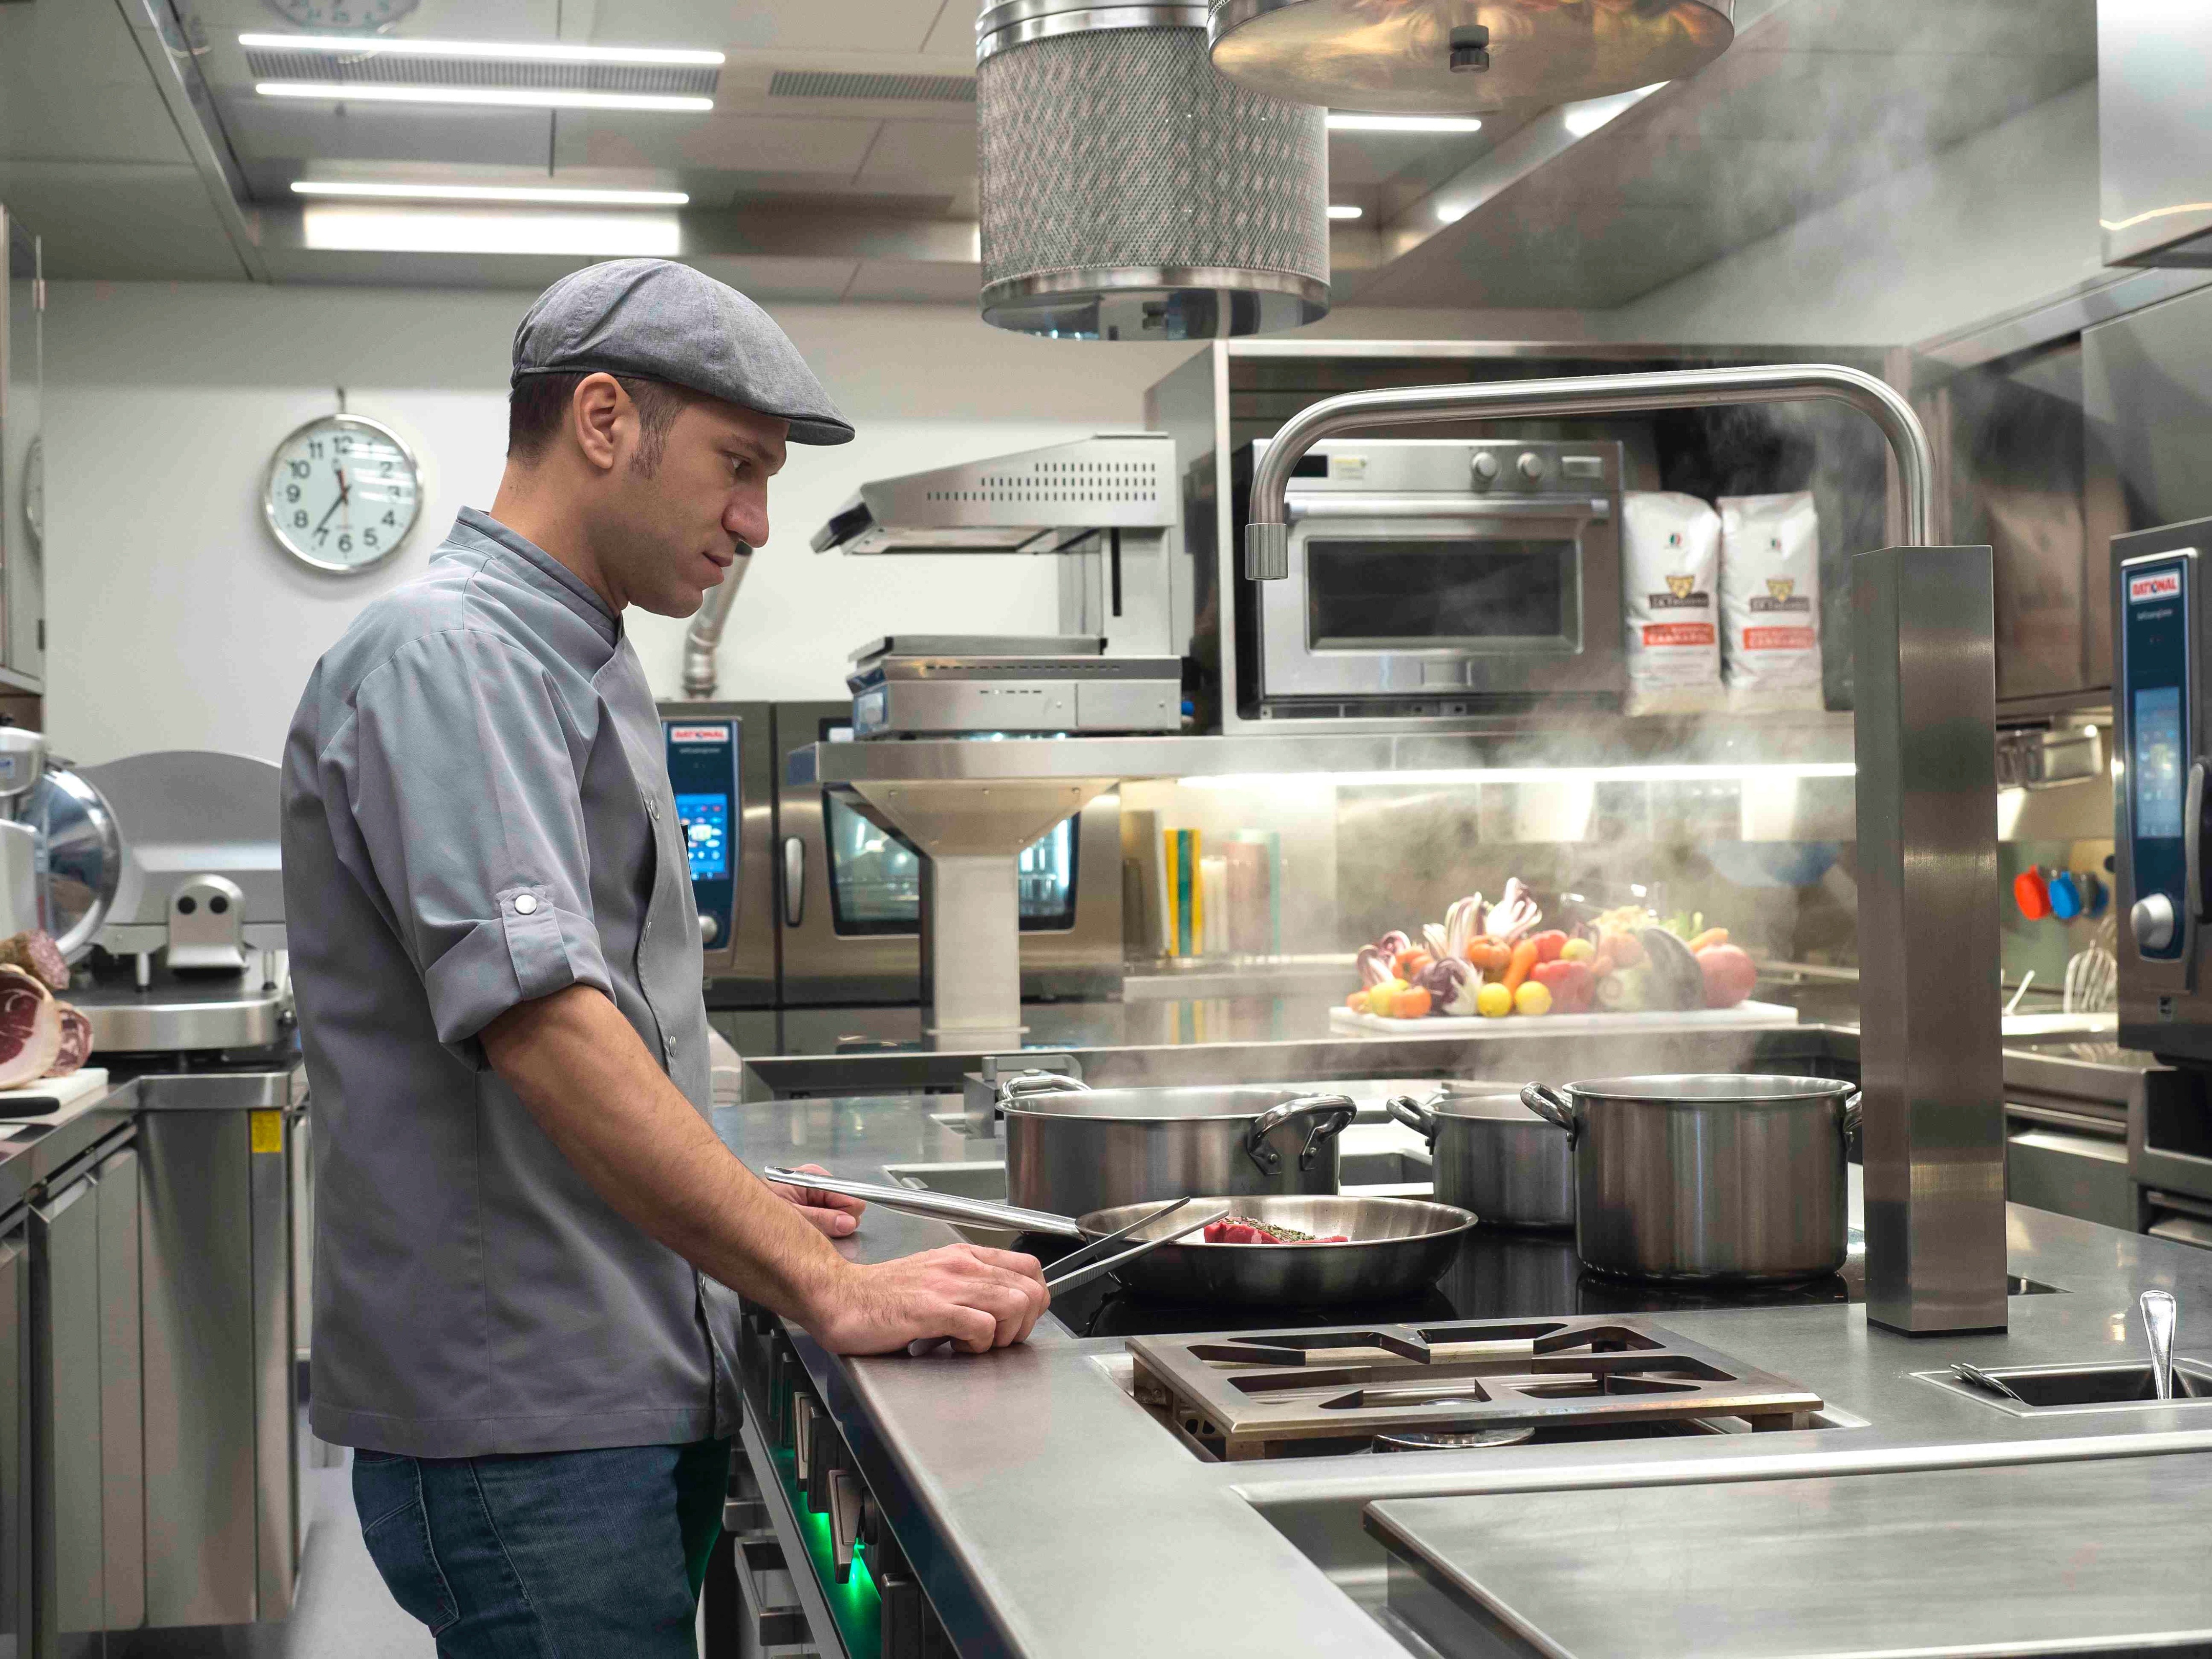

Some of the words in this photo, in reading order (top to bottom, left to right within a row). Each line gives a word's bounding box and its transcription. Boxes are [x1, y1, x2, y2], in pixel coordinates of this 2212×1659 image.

[308, 441, 324, 459] 11
[333, 435, 355, 454] 12
[290, 459, 311, 479] 10
[379, 460, 393, 479] 2
[286, 483, 301, 503] 9
[294, 509, 308, 528] 8
[381, 510, 395, 526] 4
[316, 527, 329, 546] 7
[338, 533, 353, 552] 6
[363, 528, 378, 546] 5
